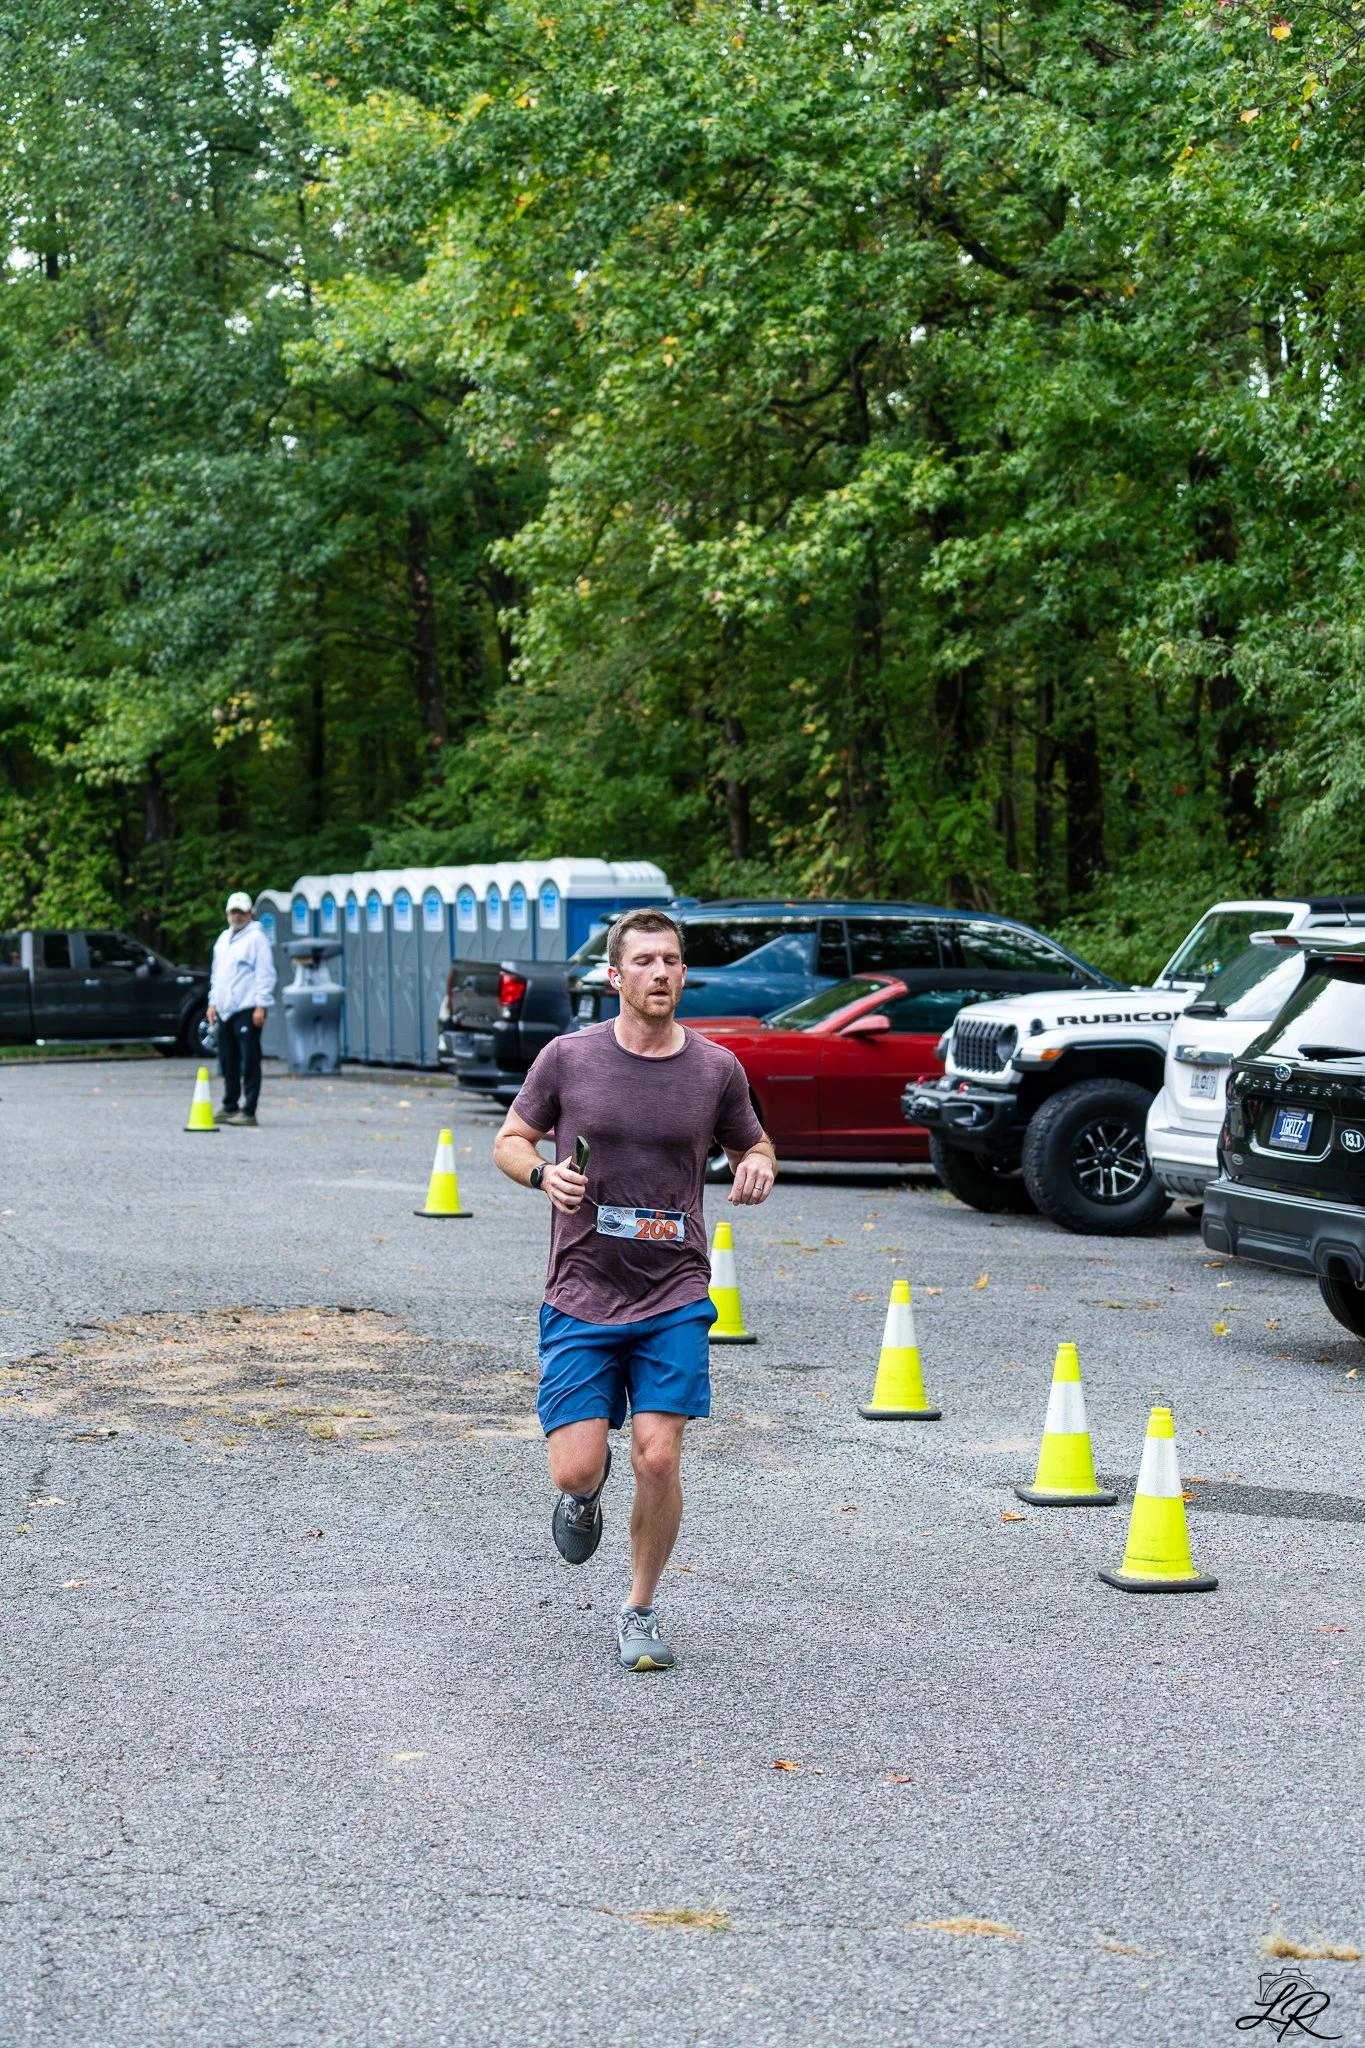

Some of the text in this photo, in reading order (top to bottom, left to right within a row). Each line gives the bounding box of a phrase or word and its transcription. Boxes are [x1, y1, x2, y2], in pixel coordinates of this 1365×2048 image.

[1243, 1077, 1333, 1097] FORESTER
[1344, 1132, 1361, 1148] 13.1
[634, 1219, 678, 1240] 200
